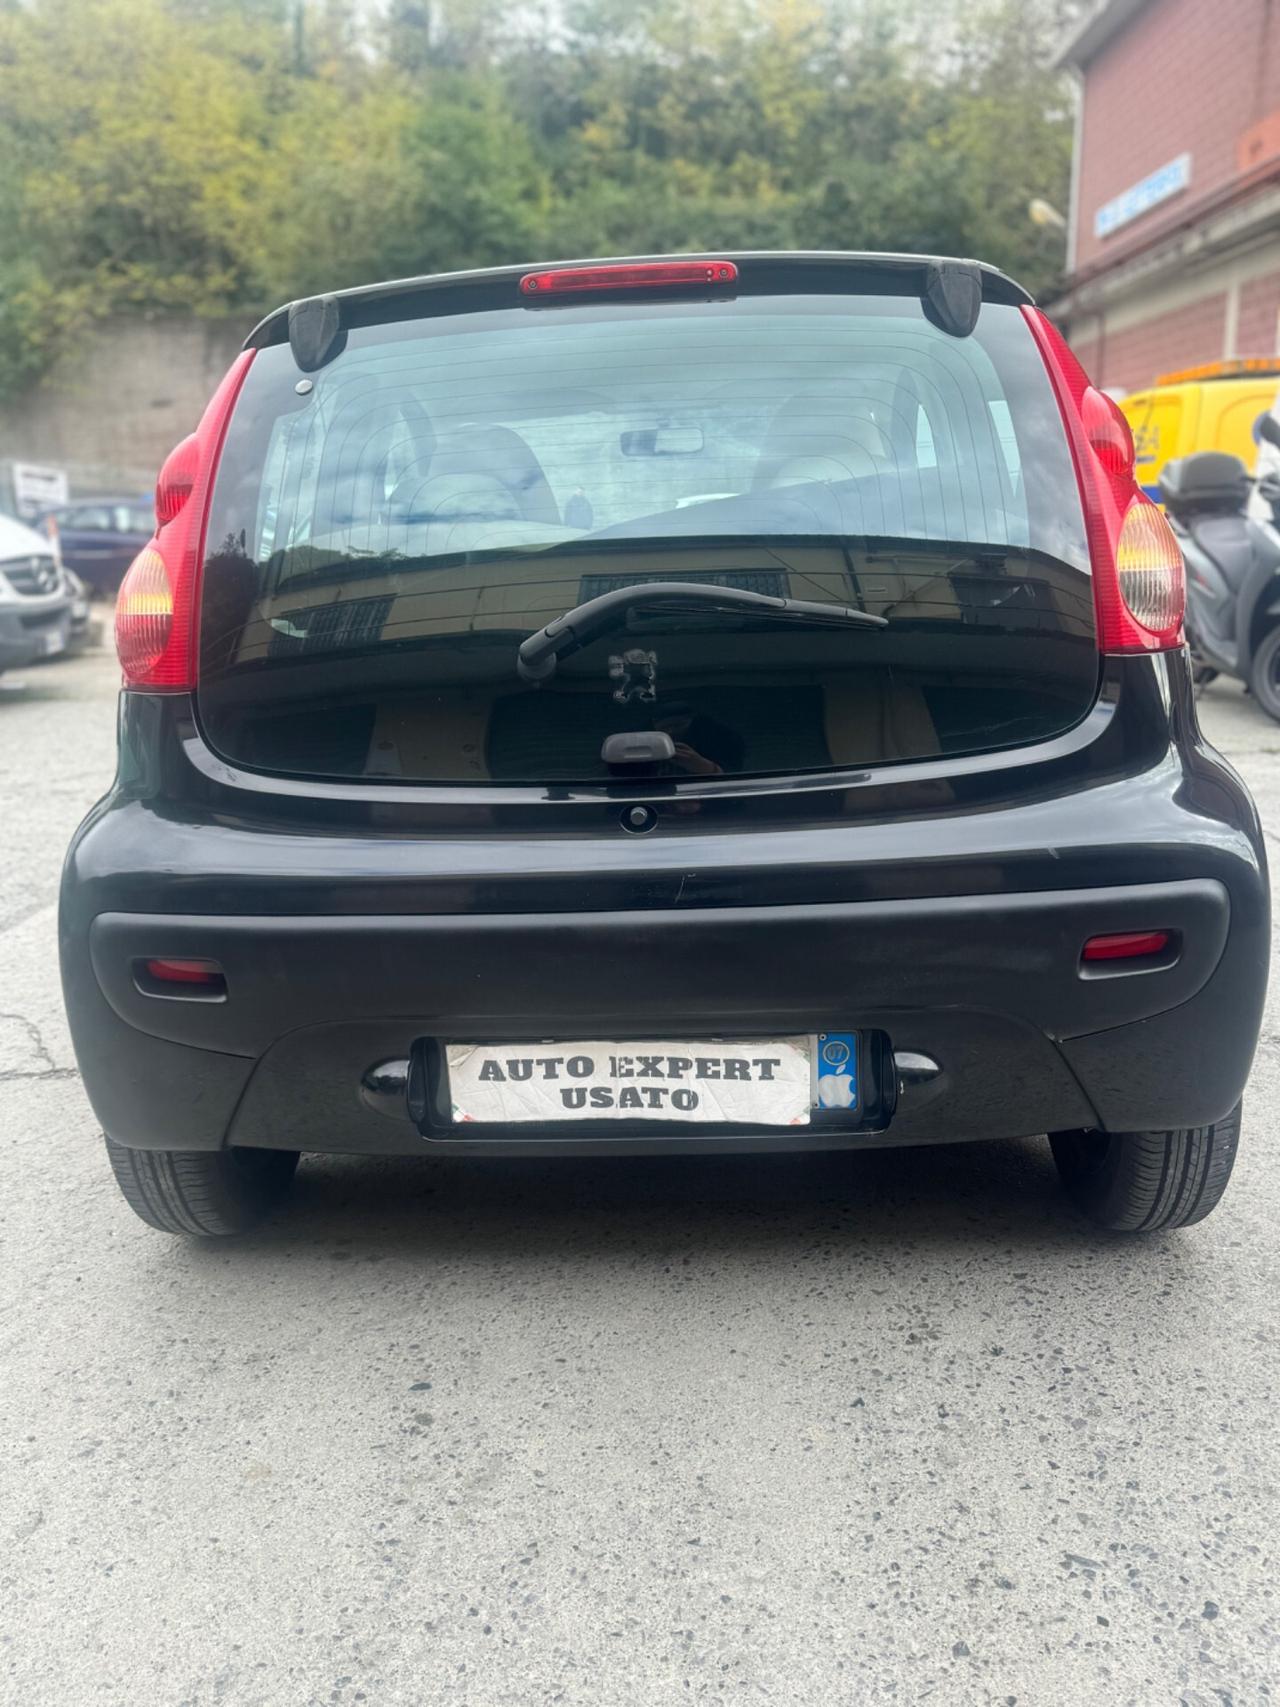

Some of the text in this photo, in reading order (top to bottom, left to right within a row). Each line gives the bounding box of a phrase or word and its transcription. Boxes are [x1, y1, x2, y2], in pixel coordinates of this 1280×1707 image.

[478, 1055, 781, 1082] AUTO EXPERT
[559, 1086, 699, 1111] USATO
